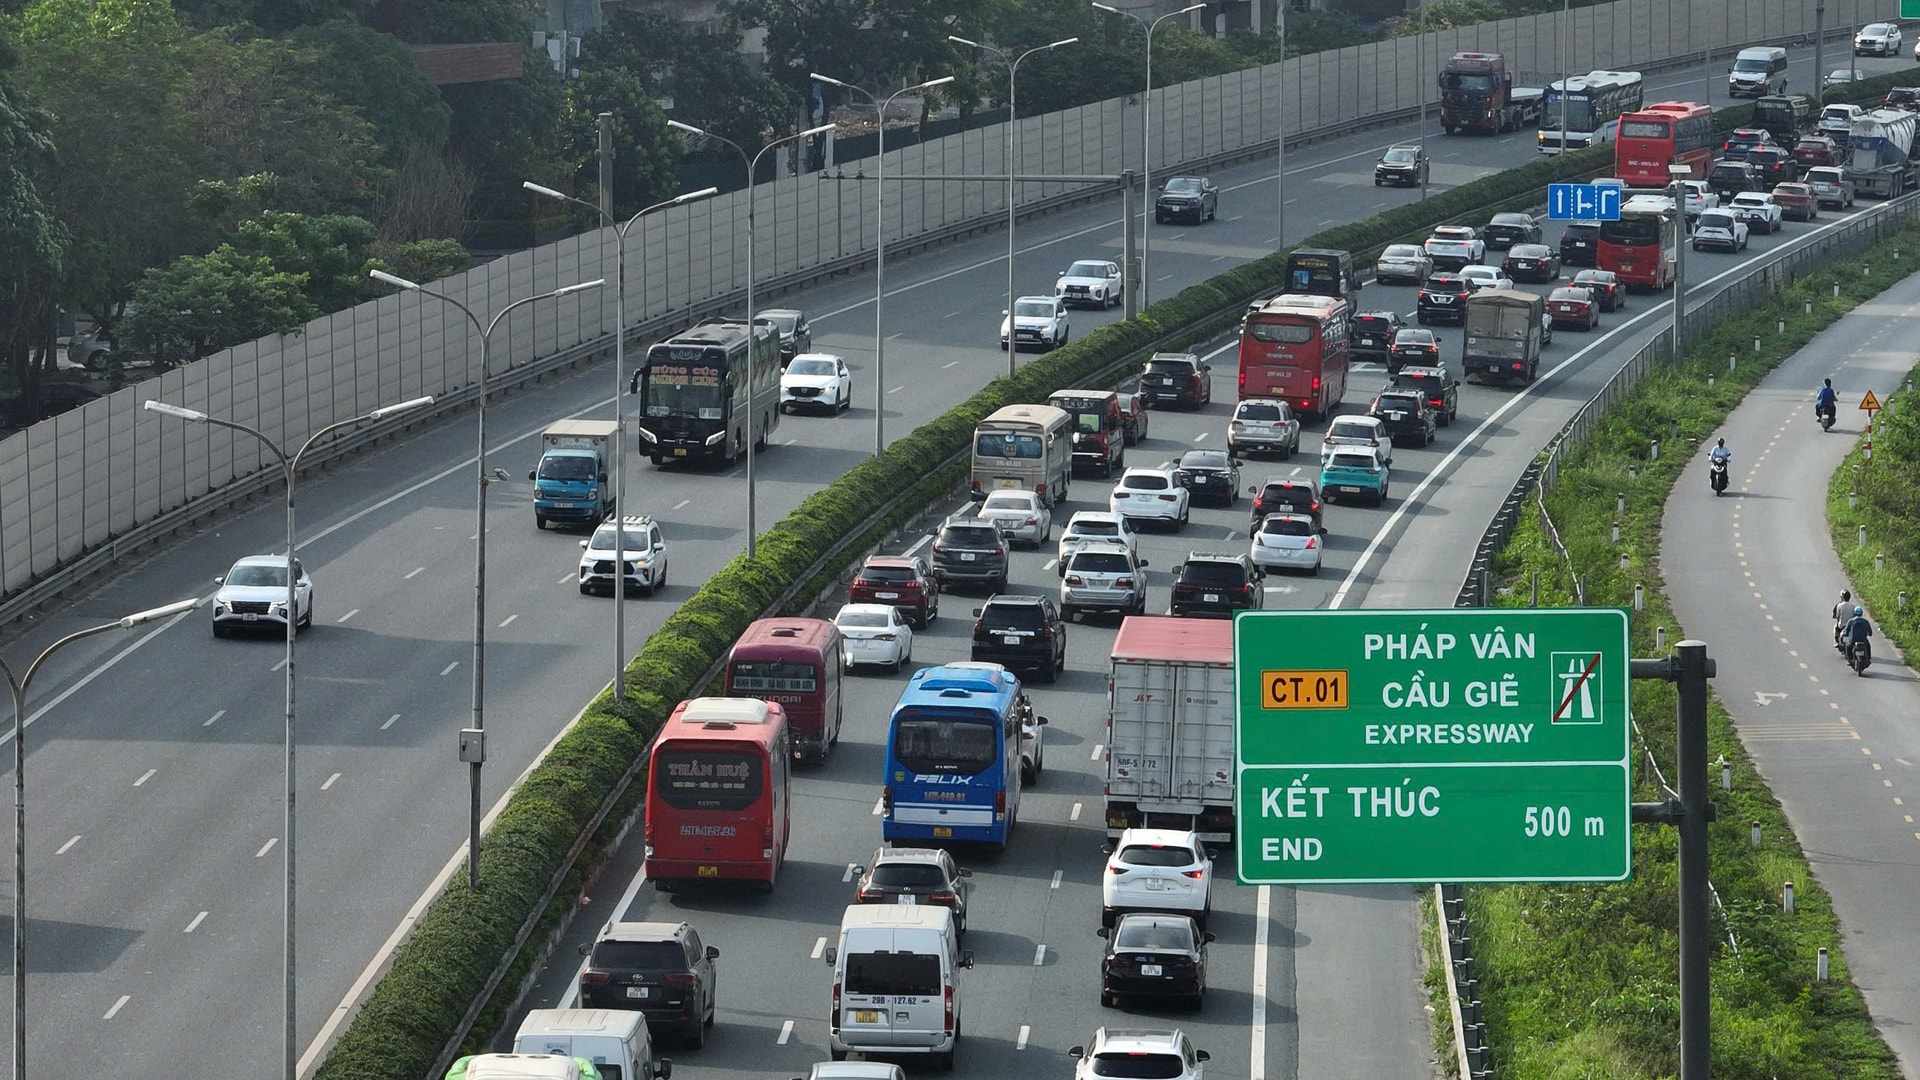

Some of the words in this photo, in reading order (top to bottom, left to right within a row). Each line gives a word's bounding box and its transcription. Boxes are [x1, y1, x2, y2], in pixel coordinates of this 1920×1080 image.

[1364, 622, 1456, 660] PHÁP
[1469, 625, 1536, 660] VÂN
[1271, 676, 1339, 703] CT.01
[1382, 669, 1450, 708] CẦU
[1464, 673, 1519, 708] GIẼ
[1365, 723, 1535, 746] EXPRESSWAY
[913, 774, 973, 785] FELIX
[1261, 774, 1330, 819] KẾT
[1347, 778, 1441, 819] THÚC
[1524, 806, 1571, 838] 500
[1584, 816, 1605, 837] m
[1261, 837, 1323, 861] END
[893, 996, 917, 1006] 127.62
